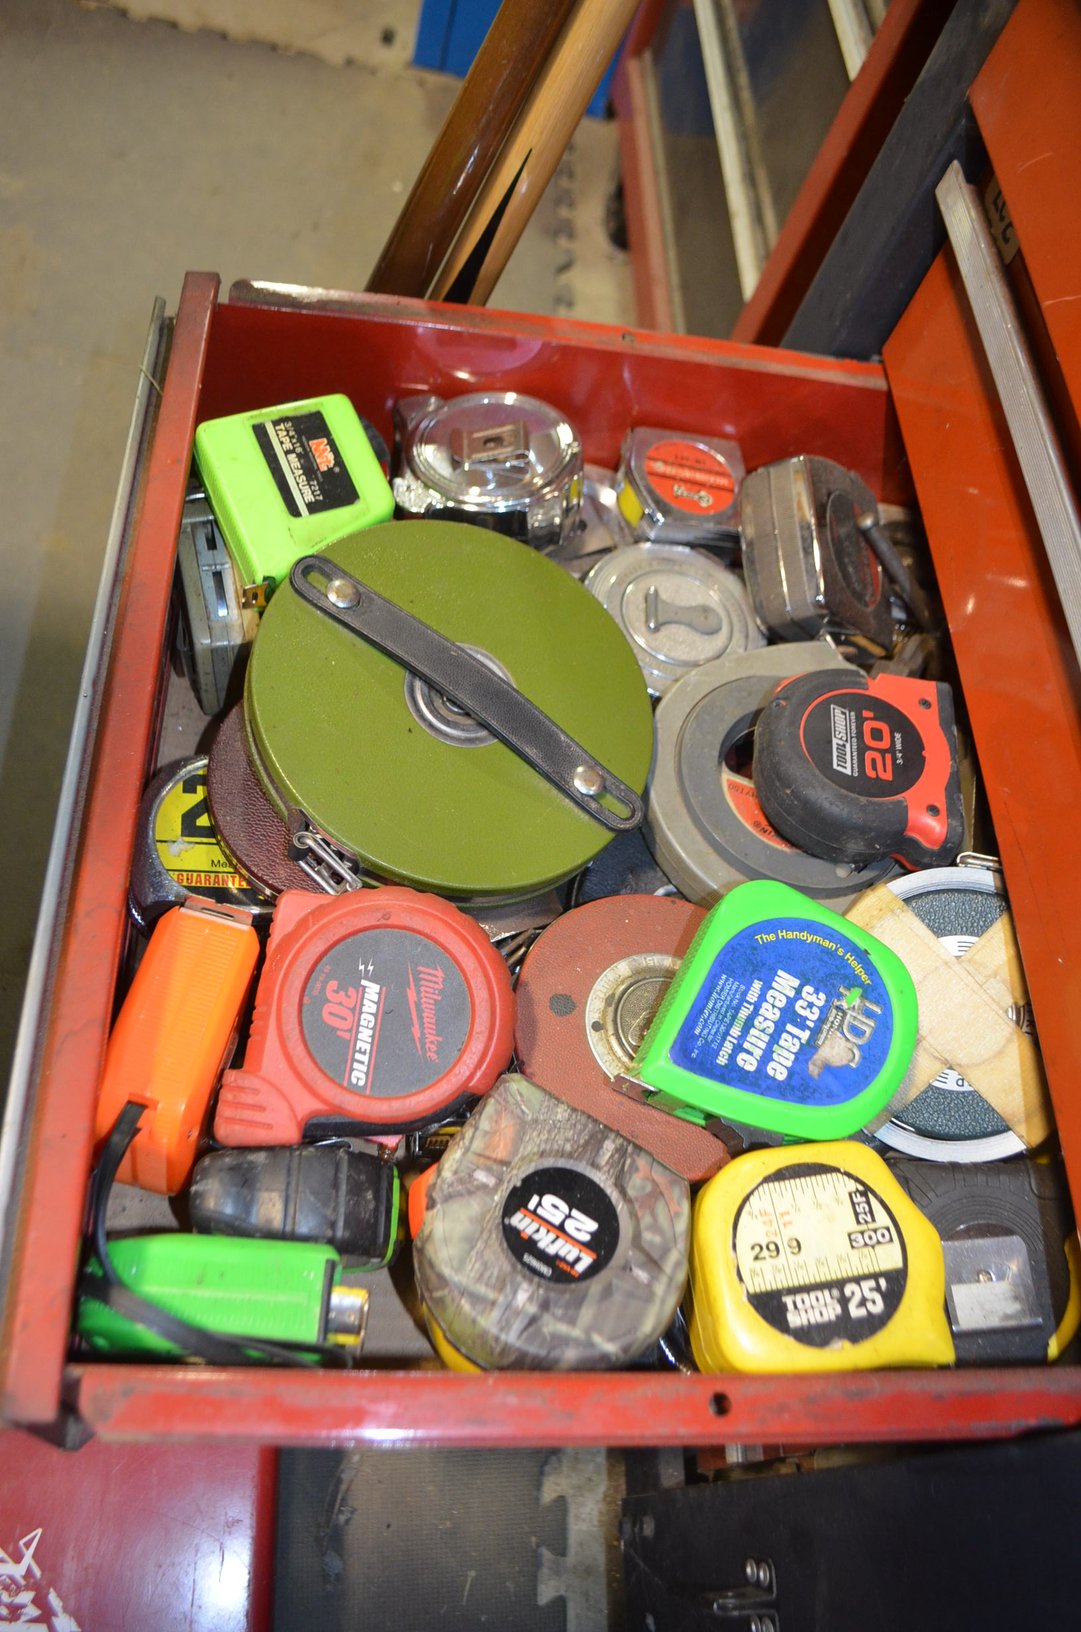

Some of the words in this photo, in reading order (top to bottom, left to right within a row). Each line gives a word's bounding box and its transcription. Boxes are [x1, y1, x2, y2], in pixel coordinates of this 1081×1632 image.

[275, 423, 293, 454] TAPE
[287, 452, 315, 504] MEASURE
[834, 708, 847, 741] SHOP
[863, 709, 893, 781] 20'
[835, 741, 847, 770] TOOL
[176, 872, 250, 887] GUARANTE
[755, 932, 777, 945] The
[777, 929, 845, 956] Handyman's
[844, 952, 872, 985] Helper
[416, 961, 447, 1064] Milwaukee
[694, 973, 727, 1036] www.homier.com
[746, 979, 763, 1003] with
[350, 979, 381, 1087] MAGNETIC
[729, 1002, 754, 1038] Thumb
[736, 969, 800, 1073] Measure
[716, 1036, 738, 1066] Latch
[766, 1023, 812, 1081] Tape
[510, 1210, 595, 1274] Lufkin
[750, 1241, 780, 1261] 29
[787, 1237, 801, 1255] 9
[851, 1229, 890, 1248] 300
[782, 1288, 831, 1311] TOOL
